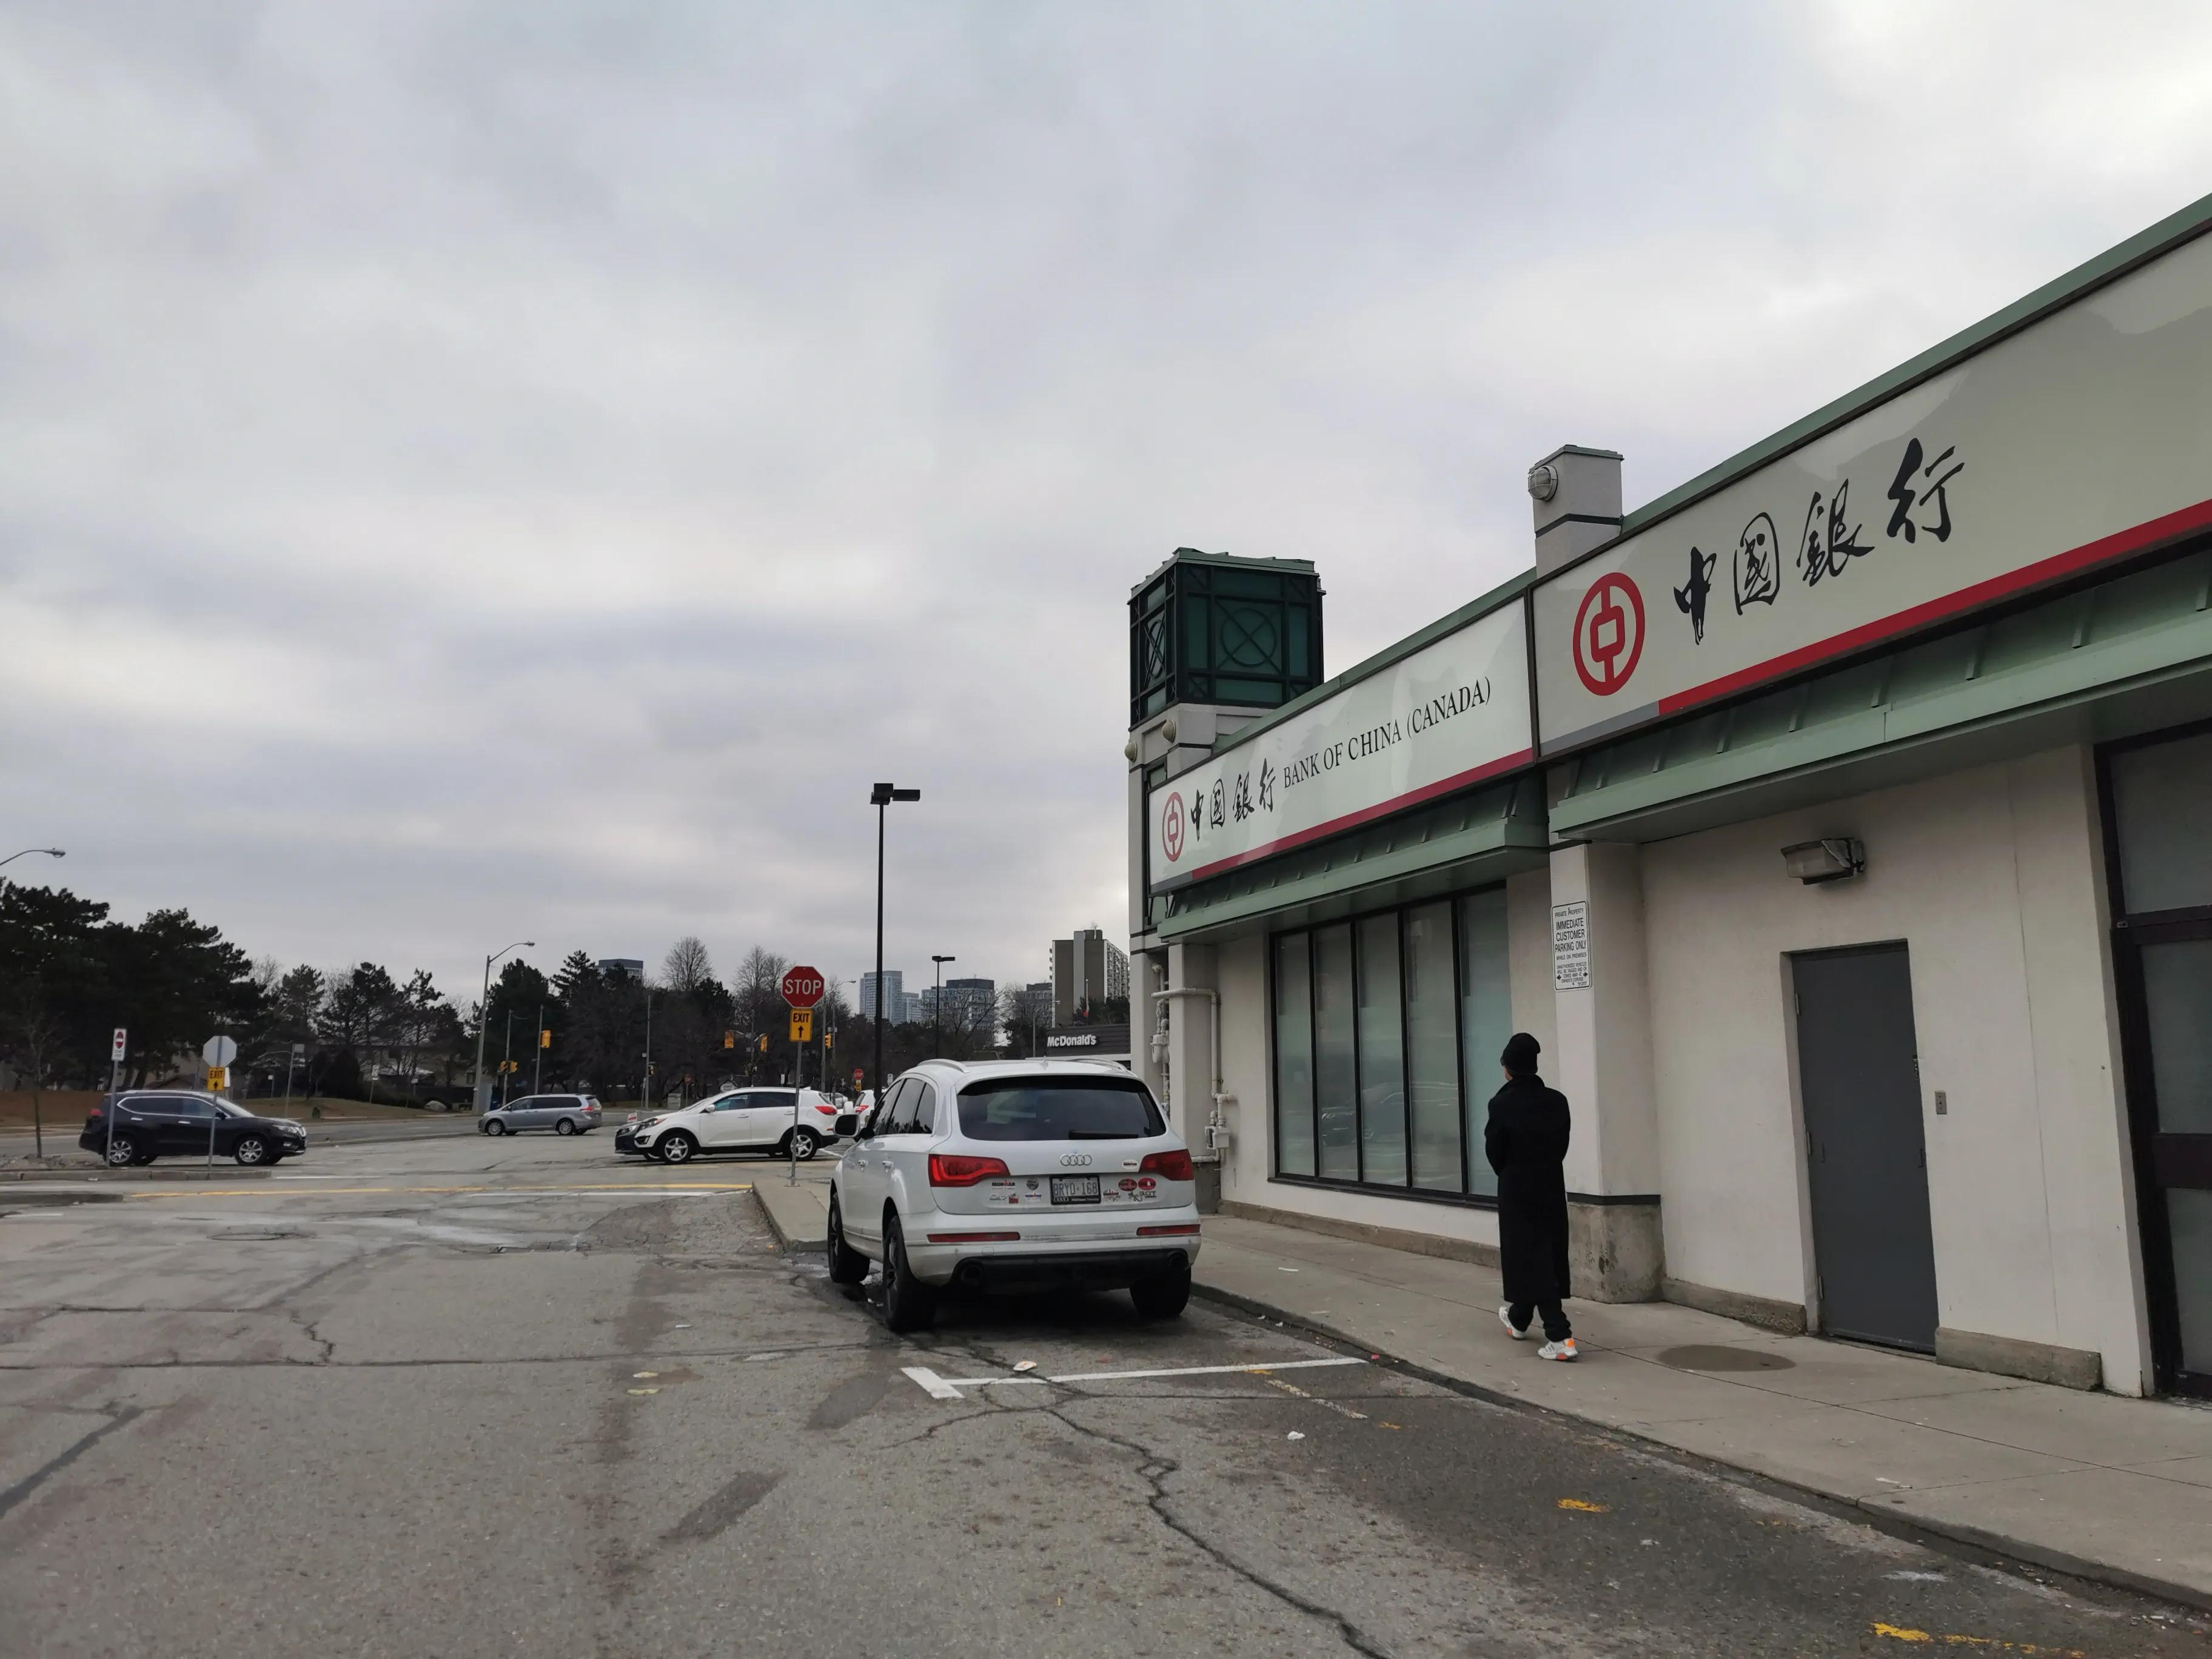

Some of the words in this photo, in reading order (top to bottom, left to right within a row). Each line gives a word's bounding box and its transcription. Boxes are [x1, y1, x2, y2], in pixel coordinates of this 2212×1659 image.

[1674, 437, 1965, 645] 中國銀行
[1284, 753, 1320, 788] BANK
[1324, 742, 1343, 770] OF
[1348, 719, 1402, 760] CHINA
[1407, 676, 1490, 739] (CANADA)
[1556, 917, 1584, 931] IMMEDIATE
[1556, 929, 1585, 941] CUSTOMER
[1555, 942, 1574, 953] PARKING
[1575, 940, 1586, 950] ONLY
[785, 979, 822, 995] STOP
[793, 1013, 809, 1023] EXIT
[1047, 1034, 1096, 1047] McDonald's
[210, 1070, 224, 1079] EXIT
[1082, 1182, 1098, 1195] 168
